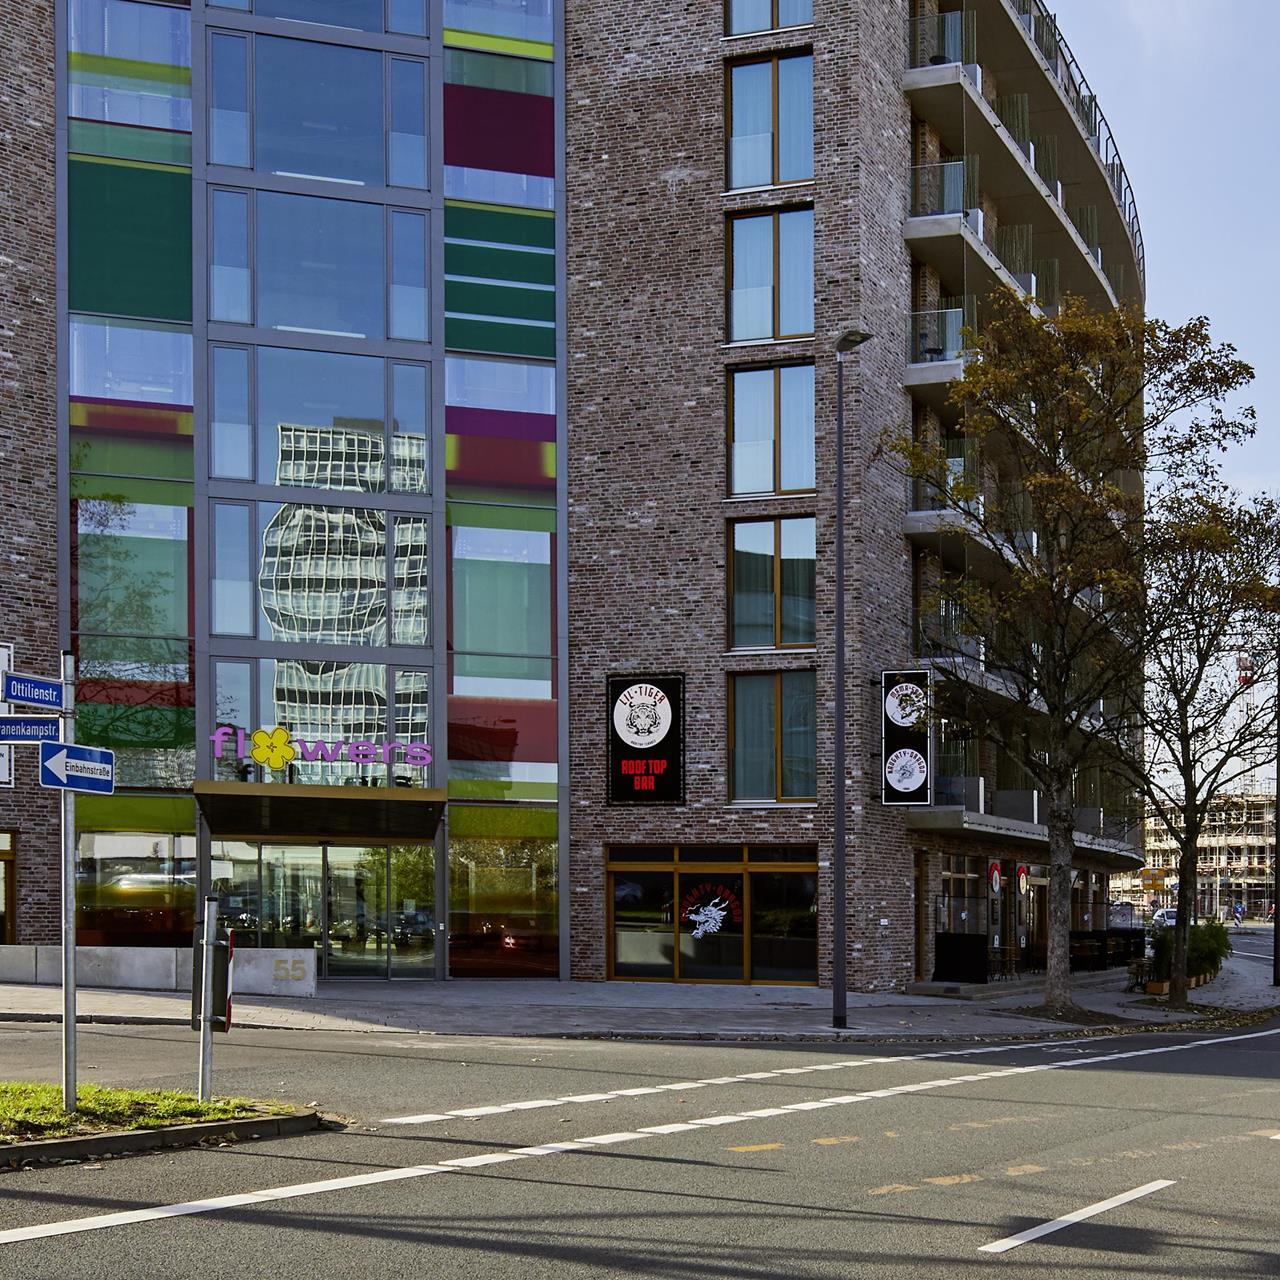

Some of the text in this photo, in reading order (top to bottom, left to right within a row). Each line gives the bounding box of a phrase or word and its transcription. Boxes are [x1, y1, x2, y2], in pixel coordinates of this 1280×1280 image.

[11, 680, 60, 702] Ottilienstr.
[638, 686, 666, 704] TIGER
[65, 761, 110, 777] Einbahnstraße
[634, 775, 655, 790] BAR
[273, 959, 306, 981] 55
